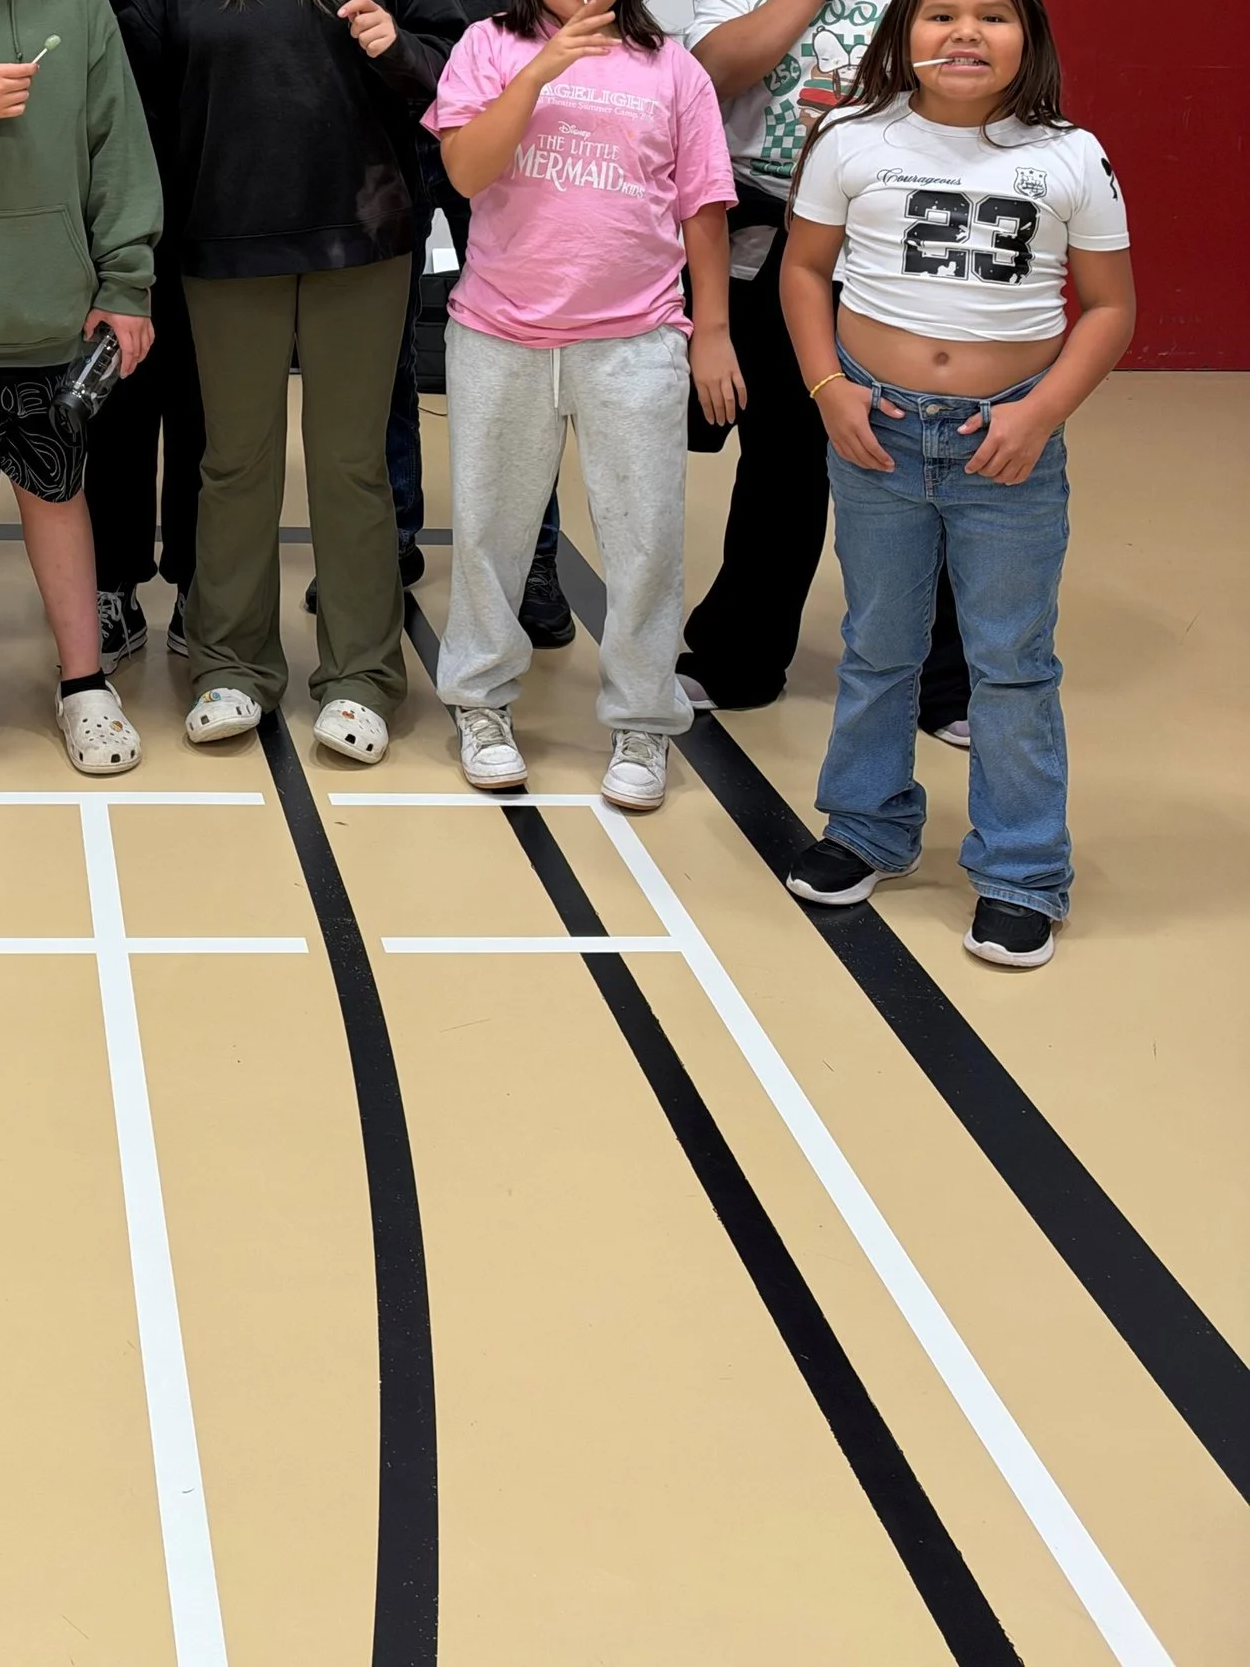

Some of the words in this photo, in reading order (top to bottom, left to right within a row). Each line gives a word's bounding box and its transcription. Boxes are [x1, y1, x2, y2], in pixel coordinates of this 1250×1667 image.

[539, 83, 658, 115] AGELIGHT
[577, 101, 614, 114] Summer
[537, 133, 566, 152] THE
[570, 138, 621, 161] LITTLE
[511, 142, 624, 192] MERMAID
[620, 180, 646, 199] KIDS
[877, 167, 963, 186] Courageous
[901, 189, 1042, 286] 23
